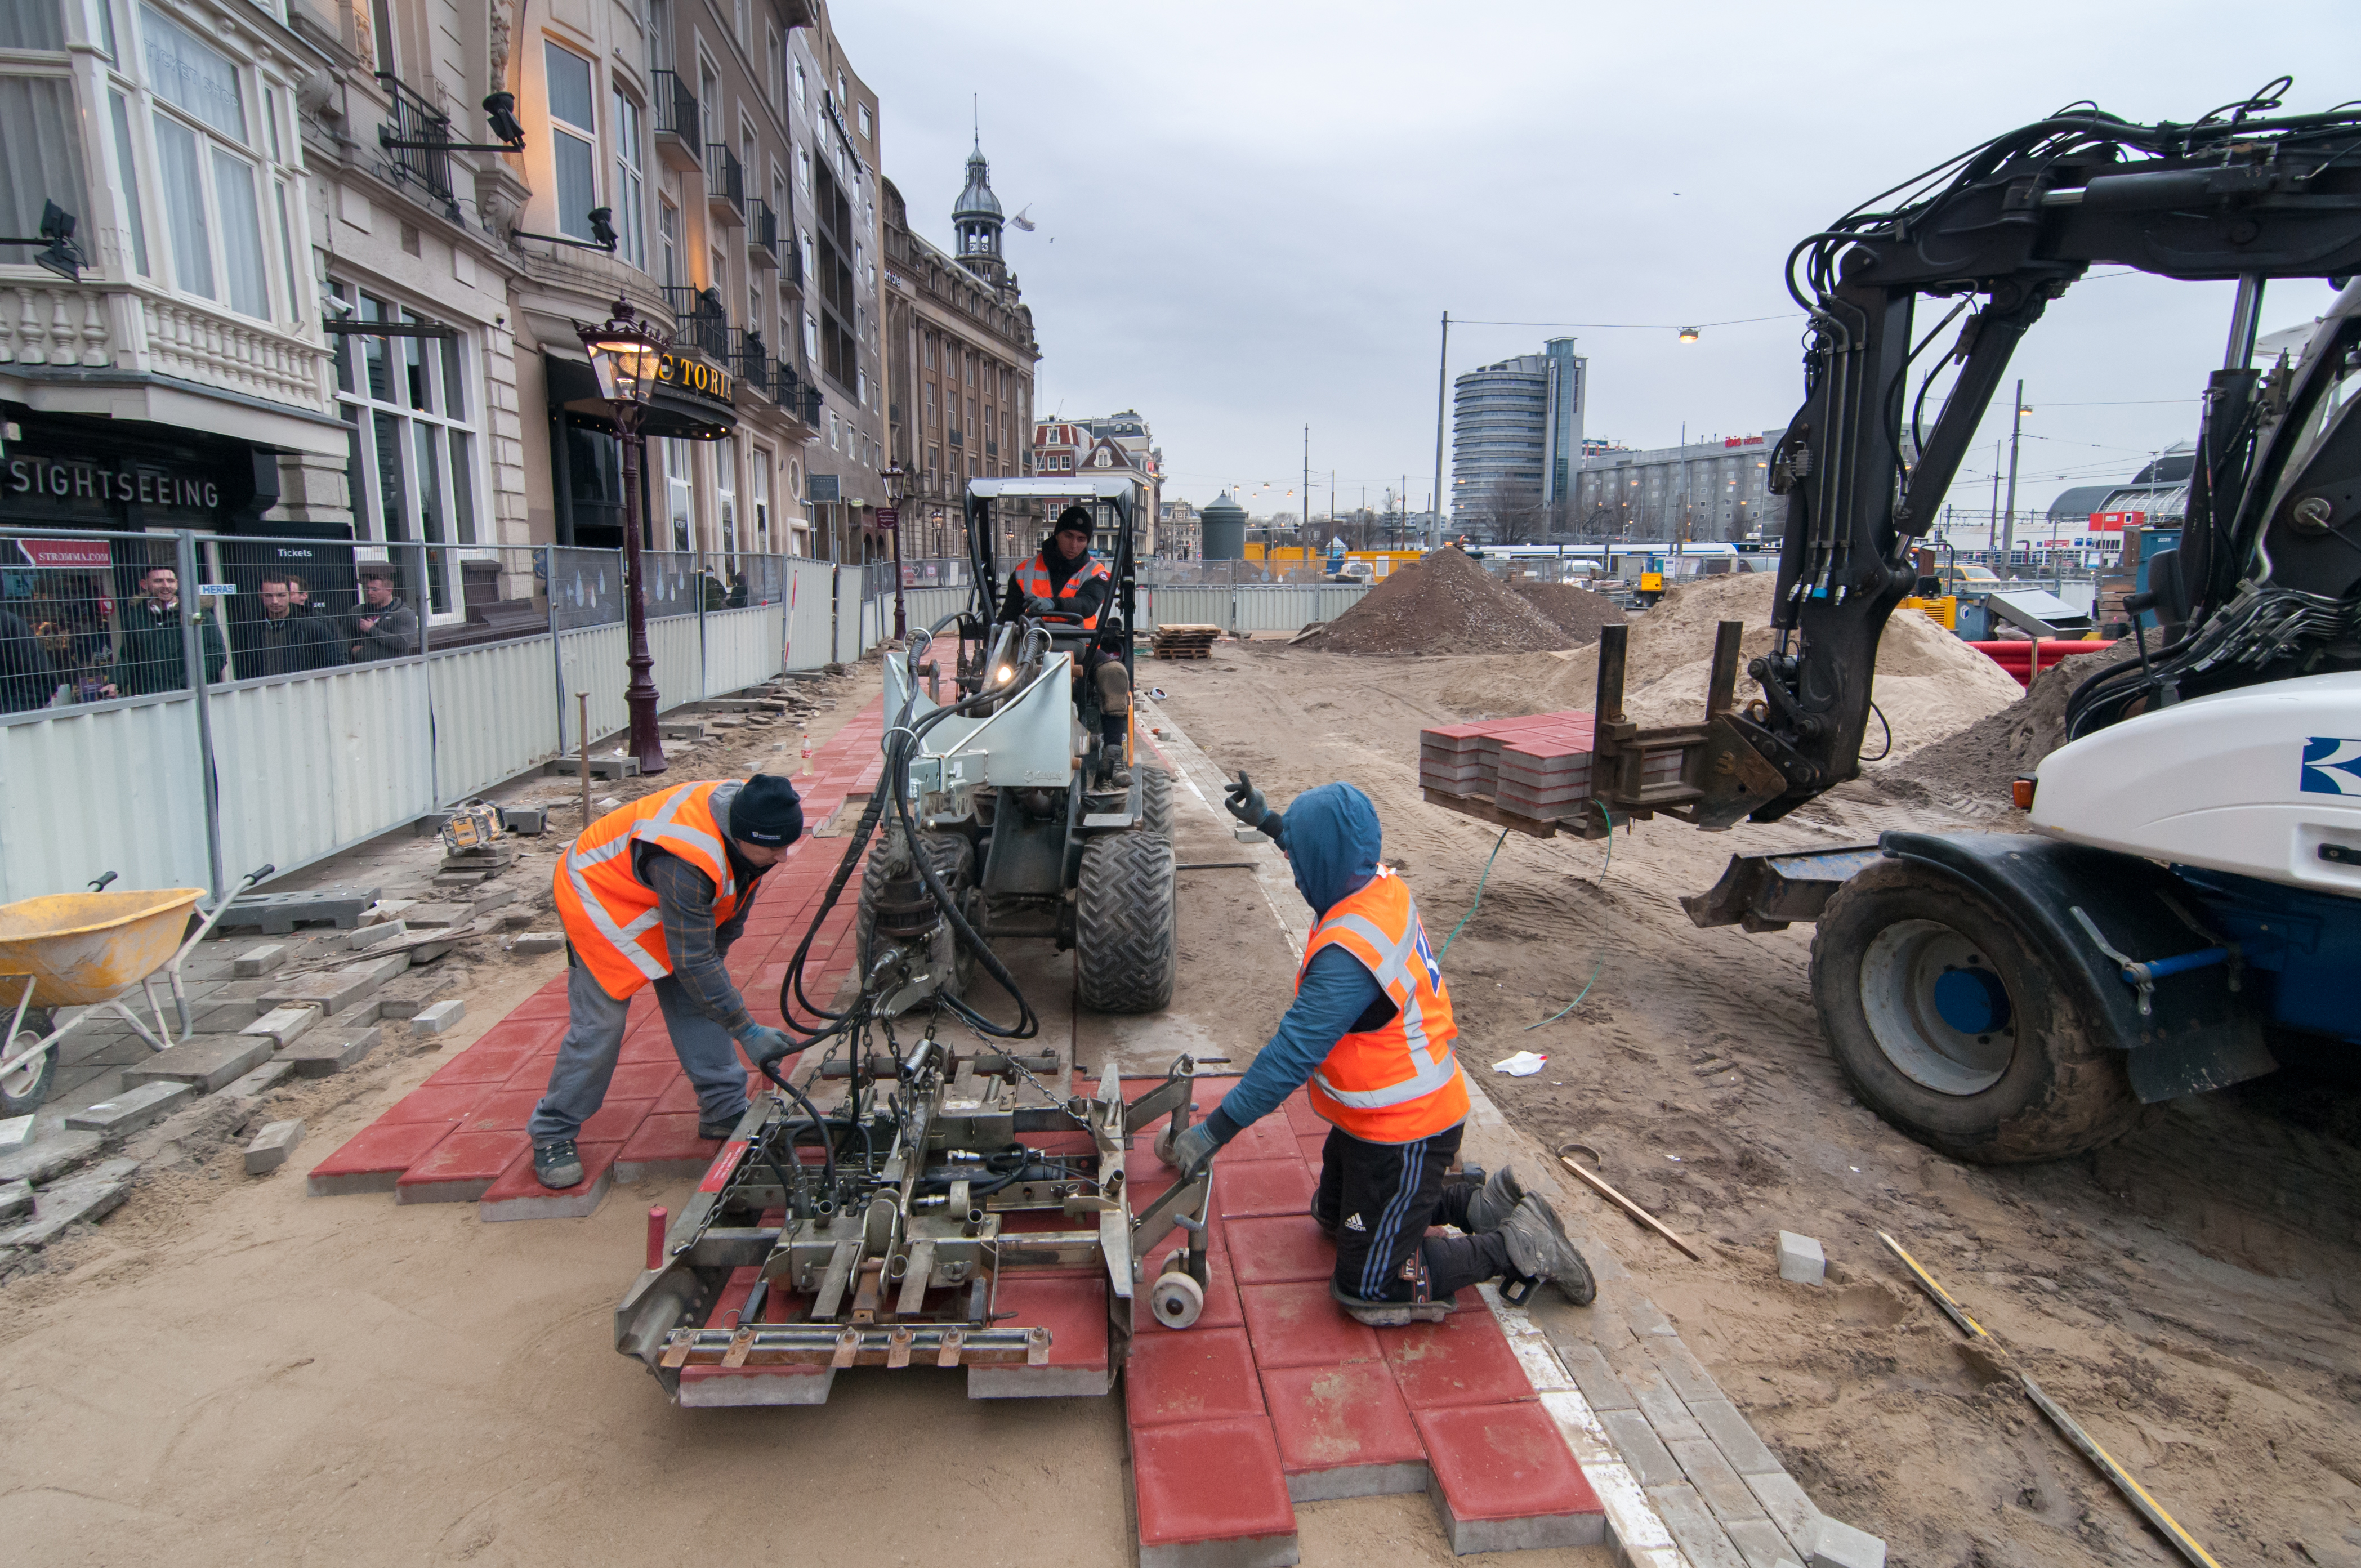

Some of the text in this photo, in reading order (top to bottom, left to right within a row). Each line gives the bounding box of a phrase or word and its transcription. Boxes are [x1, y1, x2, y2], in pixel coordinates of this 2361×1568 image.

[144, 38, 239, 108] TICKET SHOP
[658, 354, 731, 401] CTORIA
[1725, 435, 1764, 448] ibis HOTEL
[10, 461, 218, 507] SIGHTSEEING
[38, 552, 109, 561] STROMMA.COM
[278, 548, 313, 557] Tickets
[203, 584, 233, 595] HERAS
[1345, 1221, 1367, 1231] adidas
